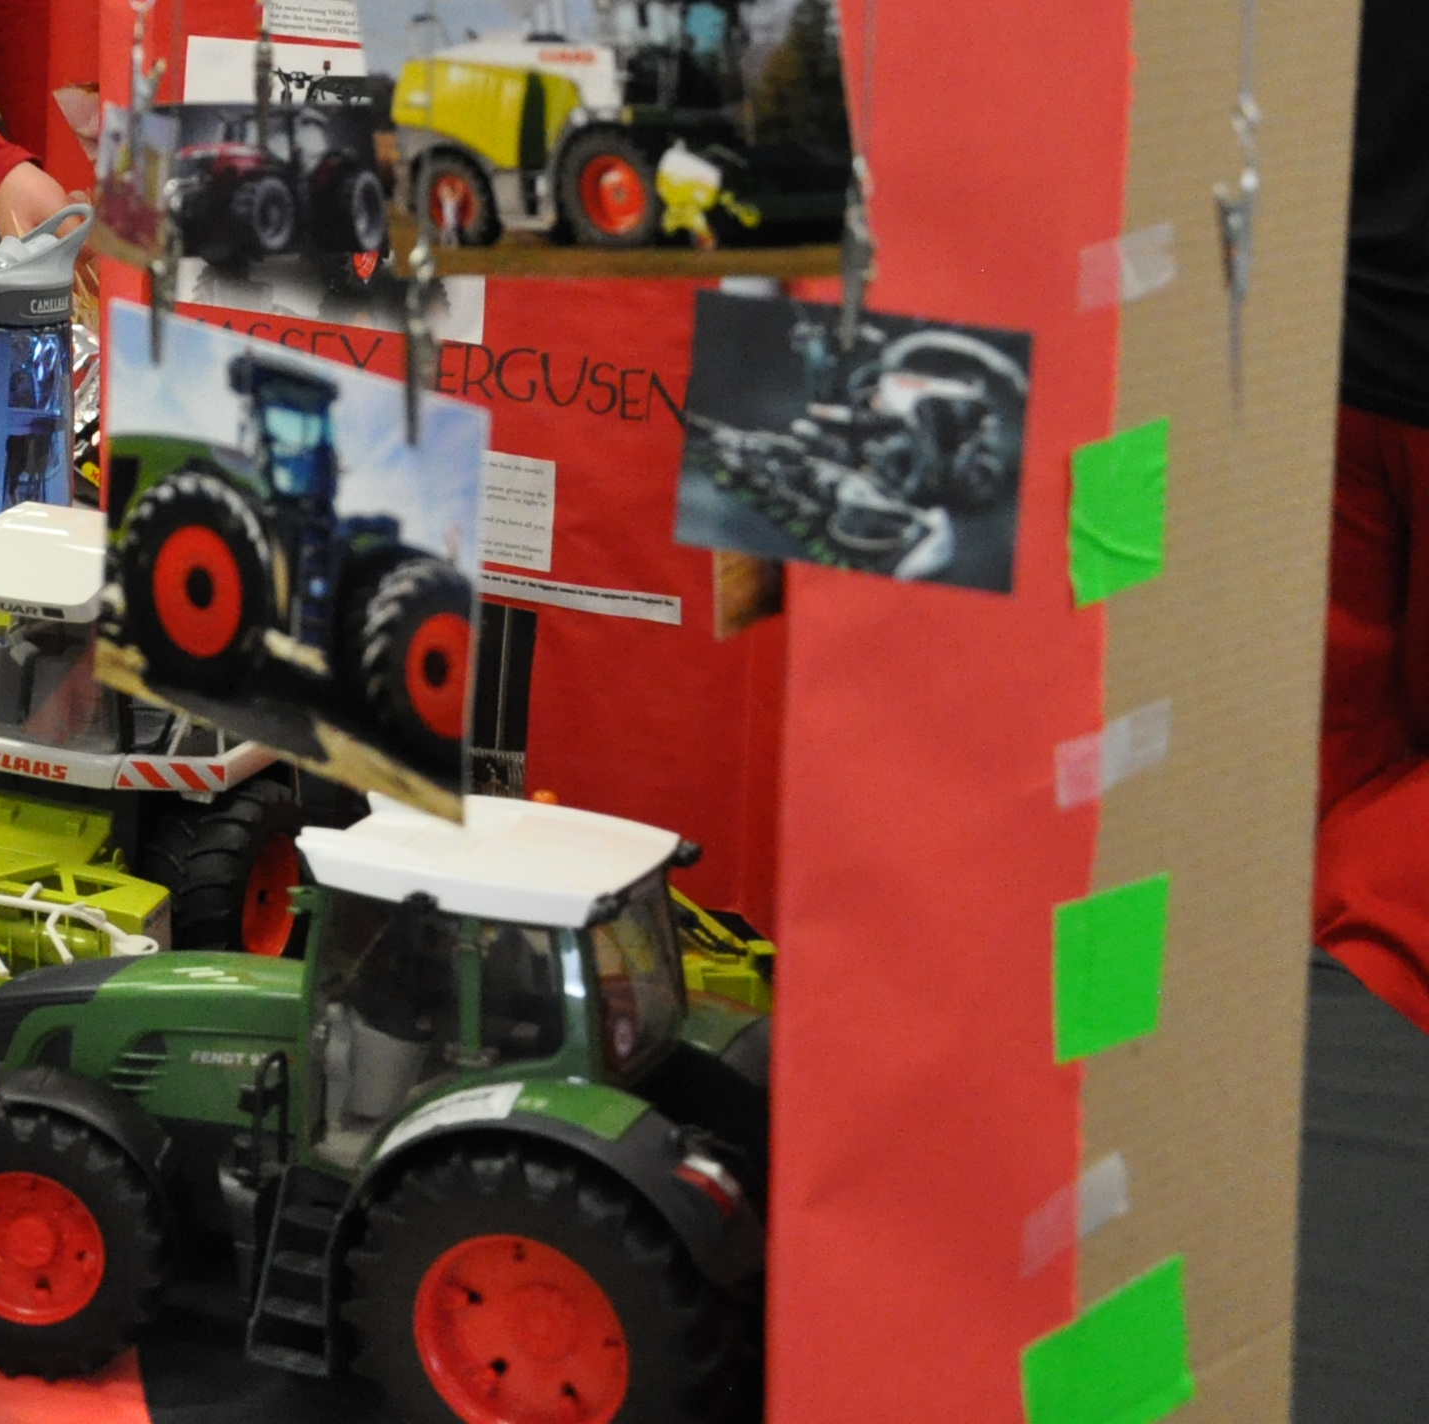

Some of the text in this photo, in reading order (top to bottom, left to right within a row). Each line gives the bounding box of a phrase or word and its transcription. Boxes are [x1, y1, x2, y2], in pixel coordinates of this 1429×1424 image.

[197, 317, 687, 429] SEY ERGUSEN
[189, 1050, 245, 1065] FENDT
